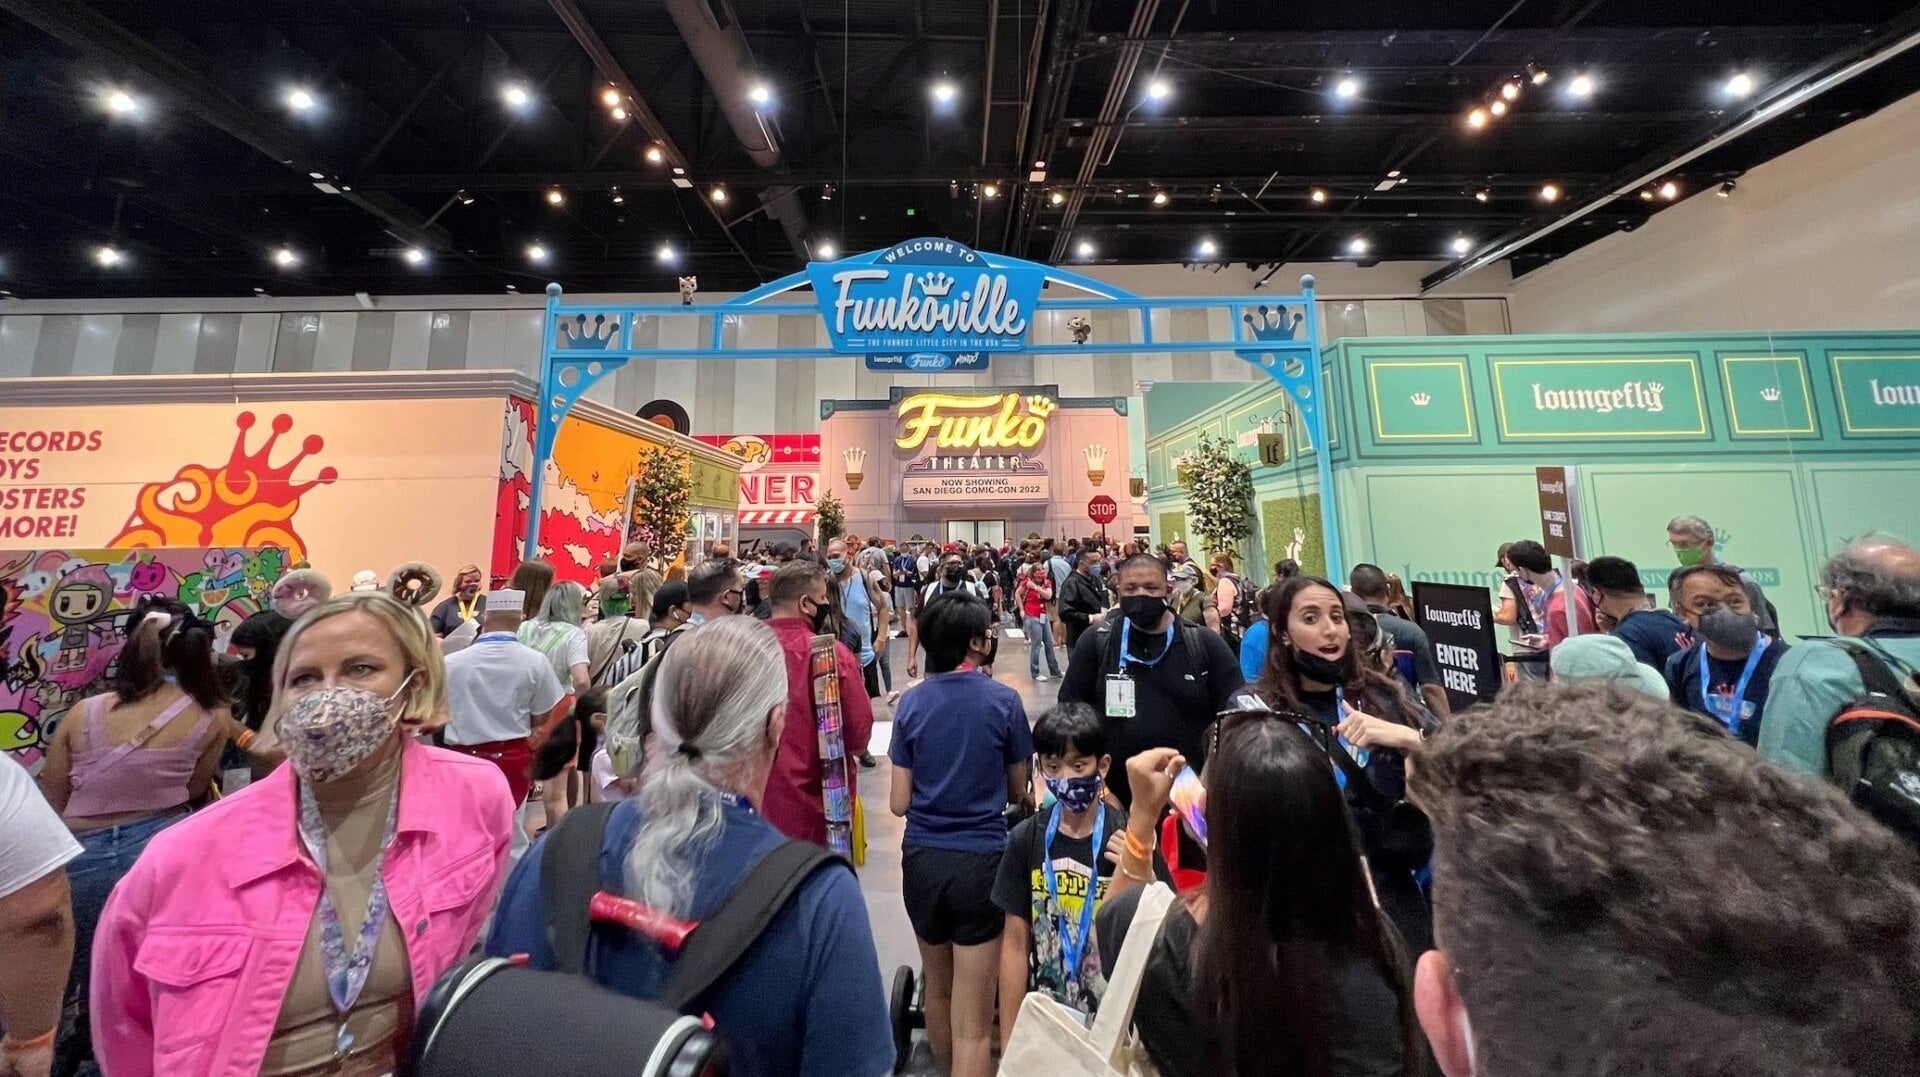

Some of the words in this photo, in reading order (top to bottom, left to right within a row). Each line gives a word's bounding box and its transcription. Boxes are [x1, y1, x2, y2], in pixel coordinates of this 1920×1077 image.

[885, 241, 954, 263] WELCOME
[958, 248, 975, 263] TO
[832, 269, 1026, 336] Funkoville
[868, 338, 880, 347] THE
[916, 338, 939, 347] LITTLE
[942, 338, 957, 347] CITY
[960, 338, 967, 347] IN
[970, 338, 982, 347] THE
[985, 338, 998, 347] USA
[910, 354, 946, 368] Funko
[1531, 382, 1664, 413] loungefly
[895, 392, 1046, 449] Funko
[929, 456, 1020, 470] THEATER
[912, 486, 932, 495] SAN
[934, 486, 963, 495] DIEGO
[965, 486, 1017, 495] COMIC-CON
[1019, 485, 1041, 494] 2022
[941, 478, 963, 487] NOW
[965, 478, 1009, 487] SHOWING
[0, 487, 86, 510] STERS
[1090, 503, 1116, 516] STOP
[1424, 604, 1482, 630] loungefly
[1435, 642, 1480, 672] ENTER
[1442, 668, 1478, 696] HERE
